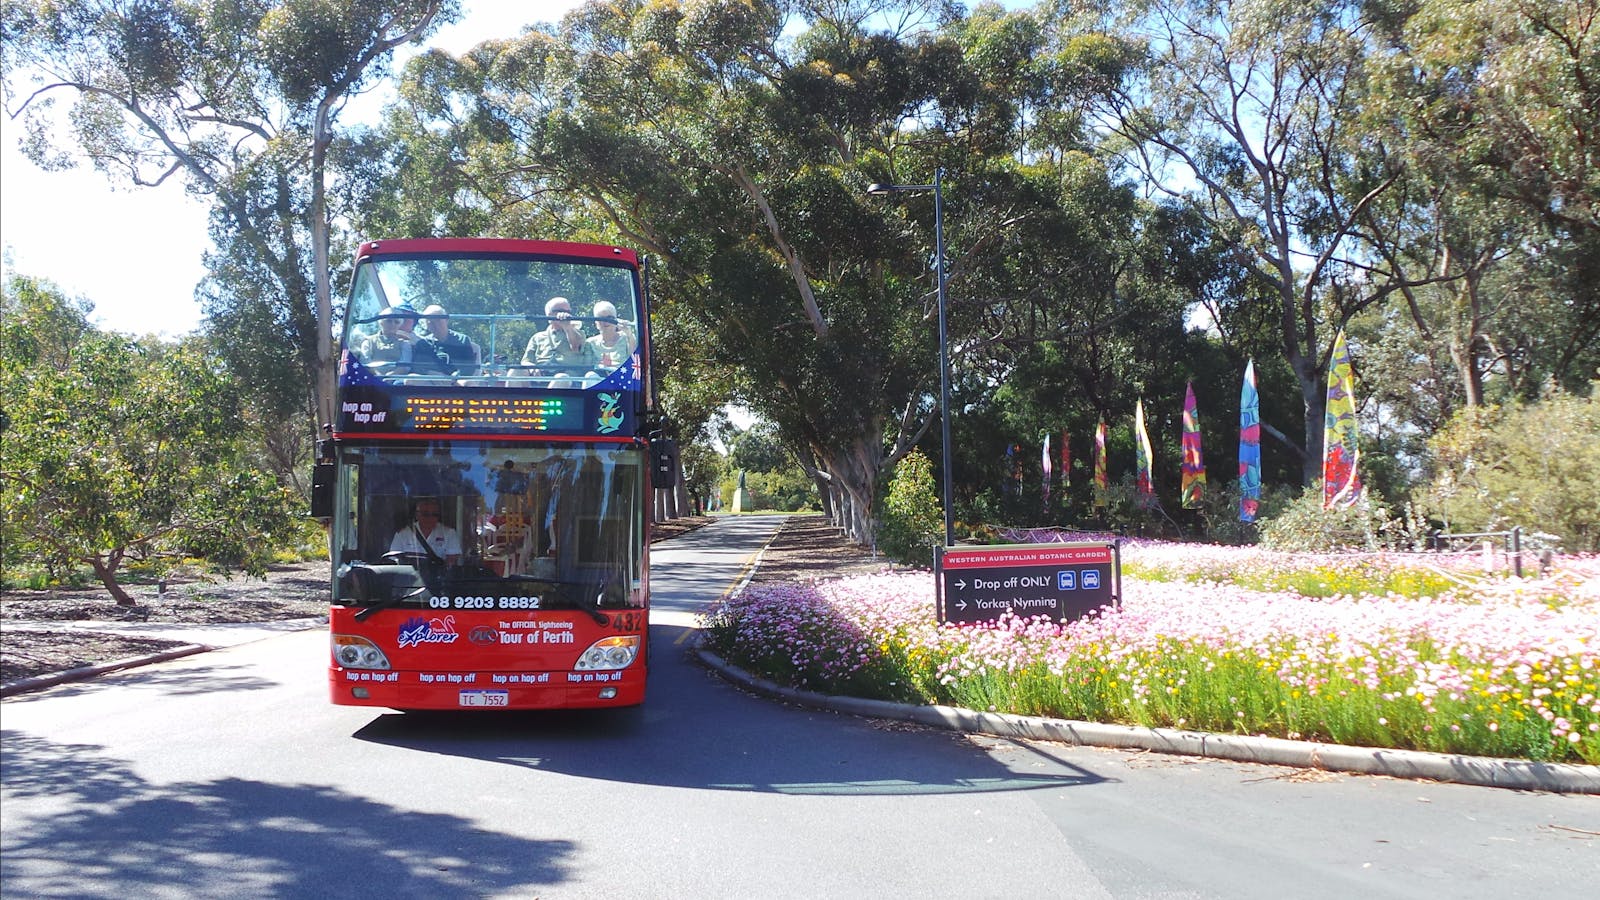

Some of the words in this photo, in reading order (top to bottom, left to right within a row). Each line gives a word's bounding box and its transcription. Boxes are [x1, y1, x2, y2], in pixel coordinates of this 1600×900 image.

[342, 401, 358, 413] hop
[360, 402, 372, 412] on
[354, 411, 370, 423] hop
[371, 412, 386, 423] off
[989, 554, 1037, 562] AUSTRALIAN
[1039, 553, 1073, 561] BOTANIC
[1075, 551, 1107, 559] GARDEN
[974, 578, 1001, 590] Drop
[1003, 577, 1018, 588] off
[1020, 575, 1051, 588] ONLY
[429, 597, 450, 609] 08
[454, 597, 495, 609] 9203
[498, 597, 539, 609] 8882
[976, 598, 1010, 610] Yorkas
[1013, 597, 1057, 610] Nynning
[499, 621, 511, 629] The
[511, 621, 537, 629] OFFICIAL
[538, 621, 573, 630] Sightseeing
[613, 612, 642, 632] 432
[499, 631, 523, 644] Tour
[526, 631, 539, 644] of
[543, 631, 574, 644] Perth
[346, 672, 359, 681] hop
[371, 672, 385, 682] hop
[387, 672, 399, 681] off
[420, 673, 433, 683] hop
[448, 673, 462, 683] hop
[464, 673, 476, 682] off
[492, 674, 507, 684] hop
[521, 674, 535, 684] hop
[537, 673, 550, 682] off
[567, 673, 581, 682] hop
[583, 673, 594, 681] on
[595, 673, 609, 682] hop
[611, 672, 621, 680] off
[463, 695, 475, 705] TC
[483, 695, 504, 705] 7552
